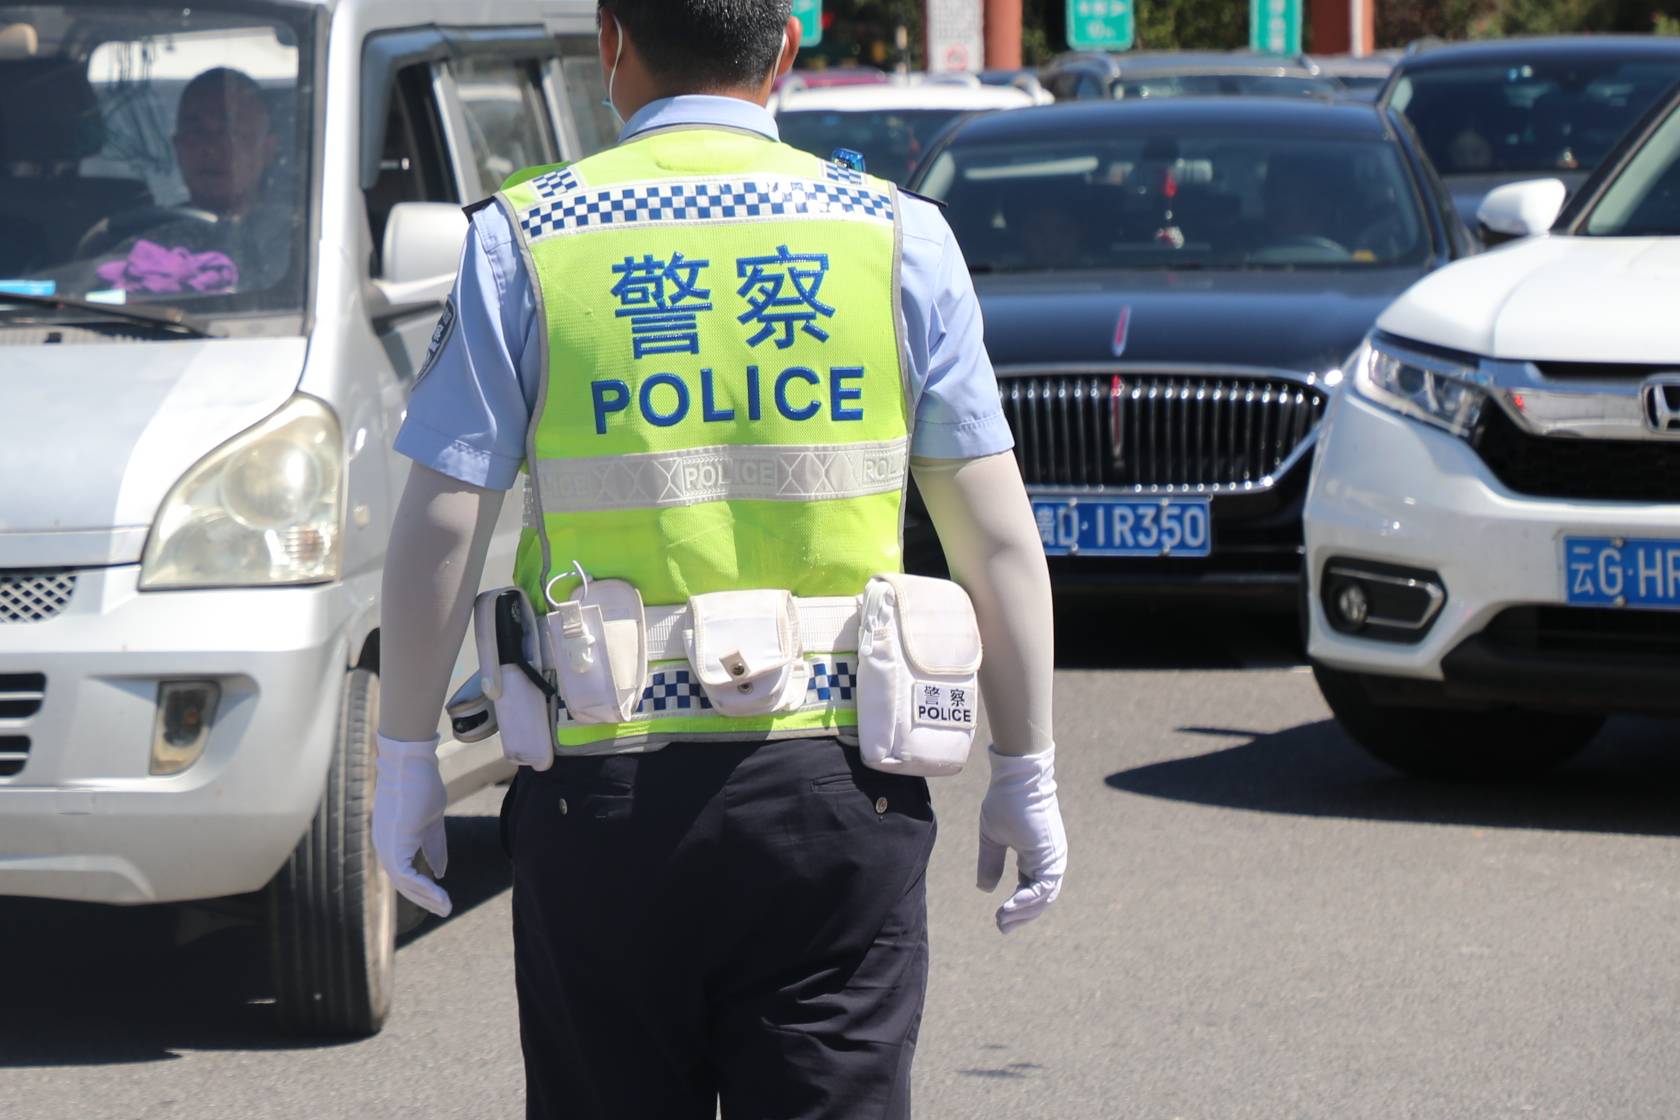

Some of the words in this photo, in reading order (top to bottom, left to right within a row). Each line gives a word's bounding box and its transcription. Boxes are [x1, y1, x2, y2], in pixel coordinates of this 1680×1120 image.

[611, 245, 835, 359] 警察
[590, 365, 864, 435] POLICE
[685, 458, 775, 489] POLICE
[924, 685, 965, 707] 警察
[918, 706, 972, 722] POLICE
